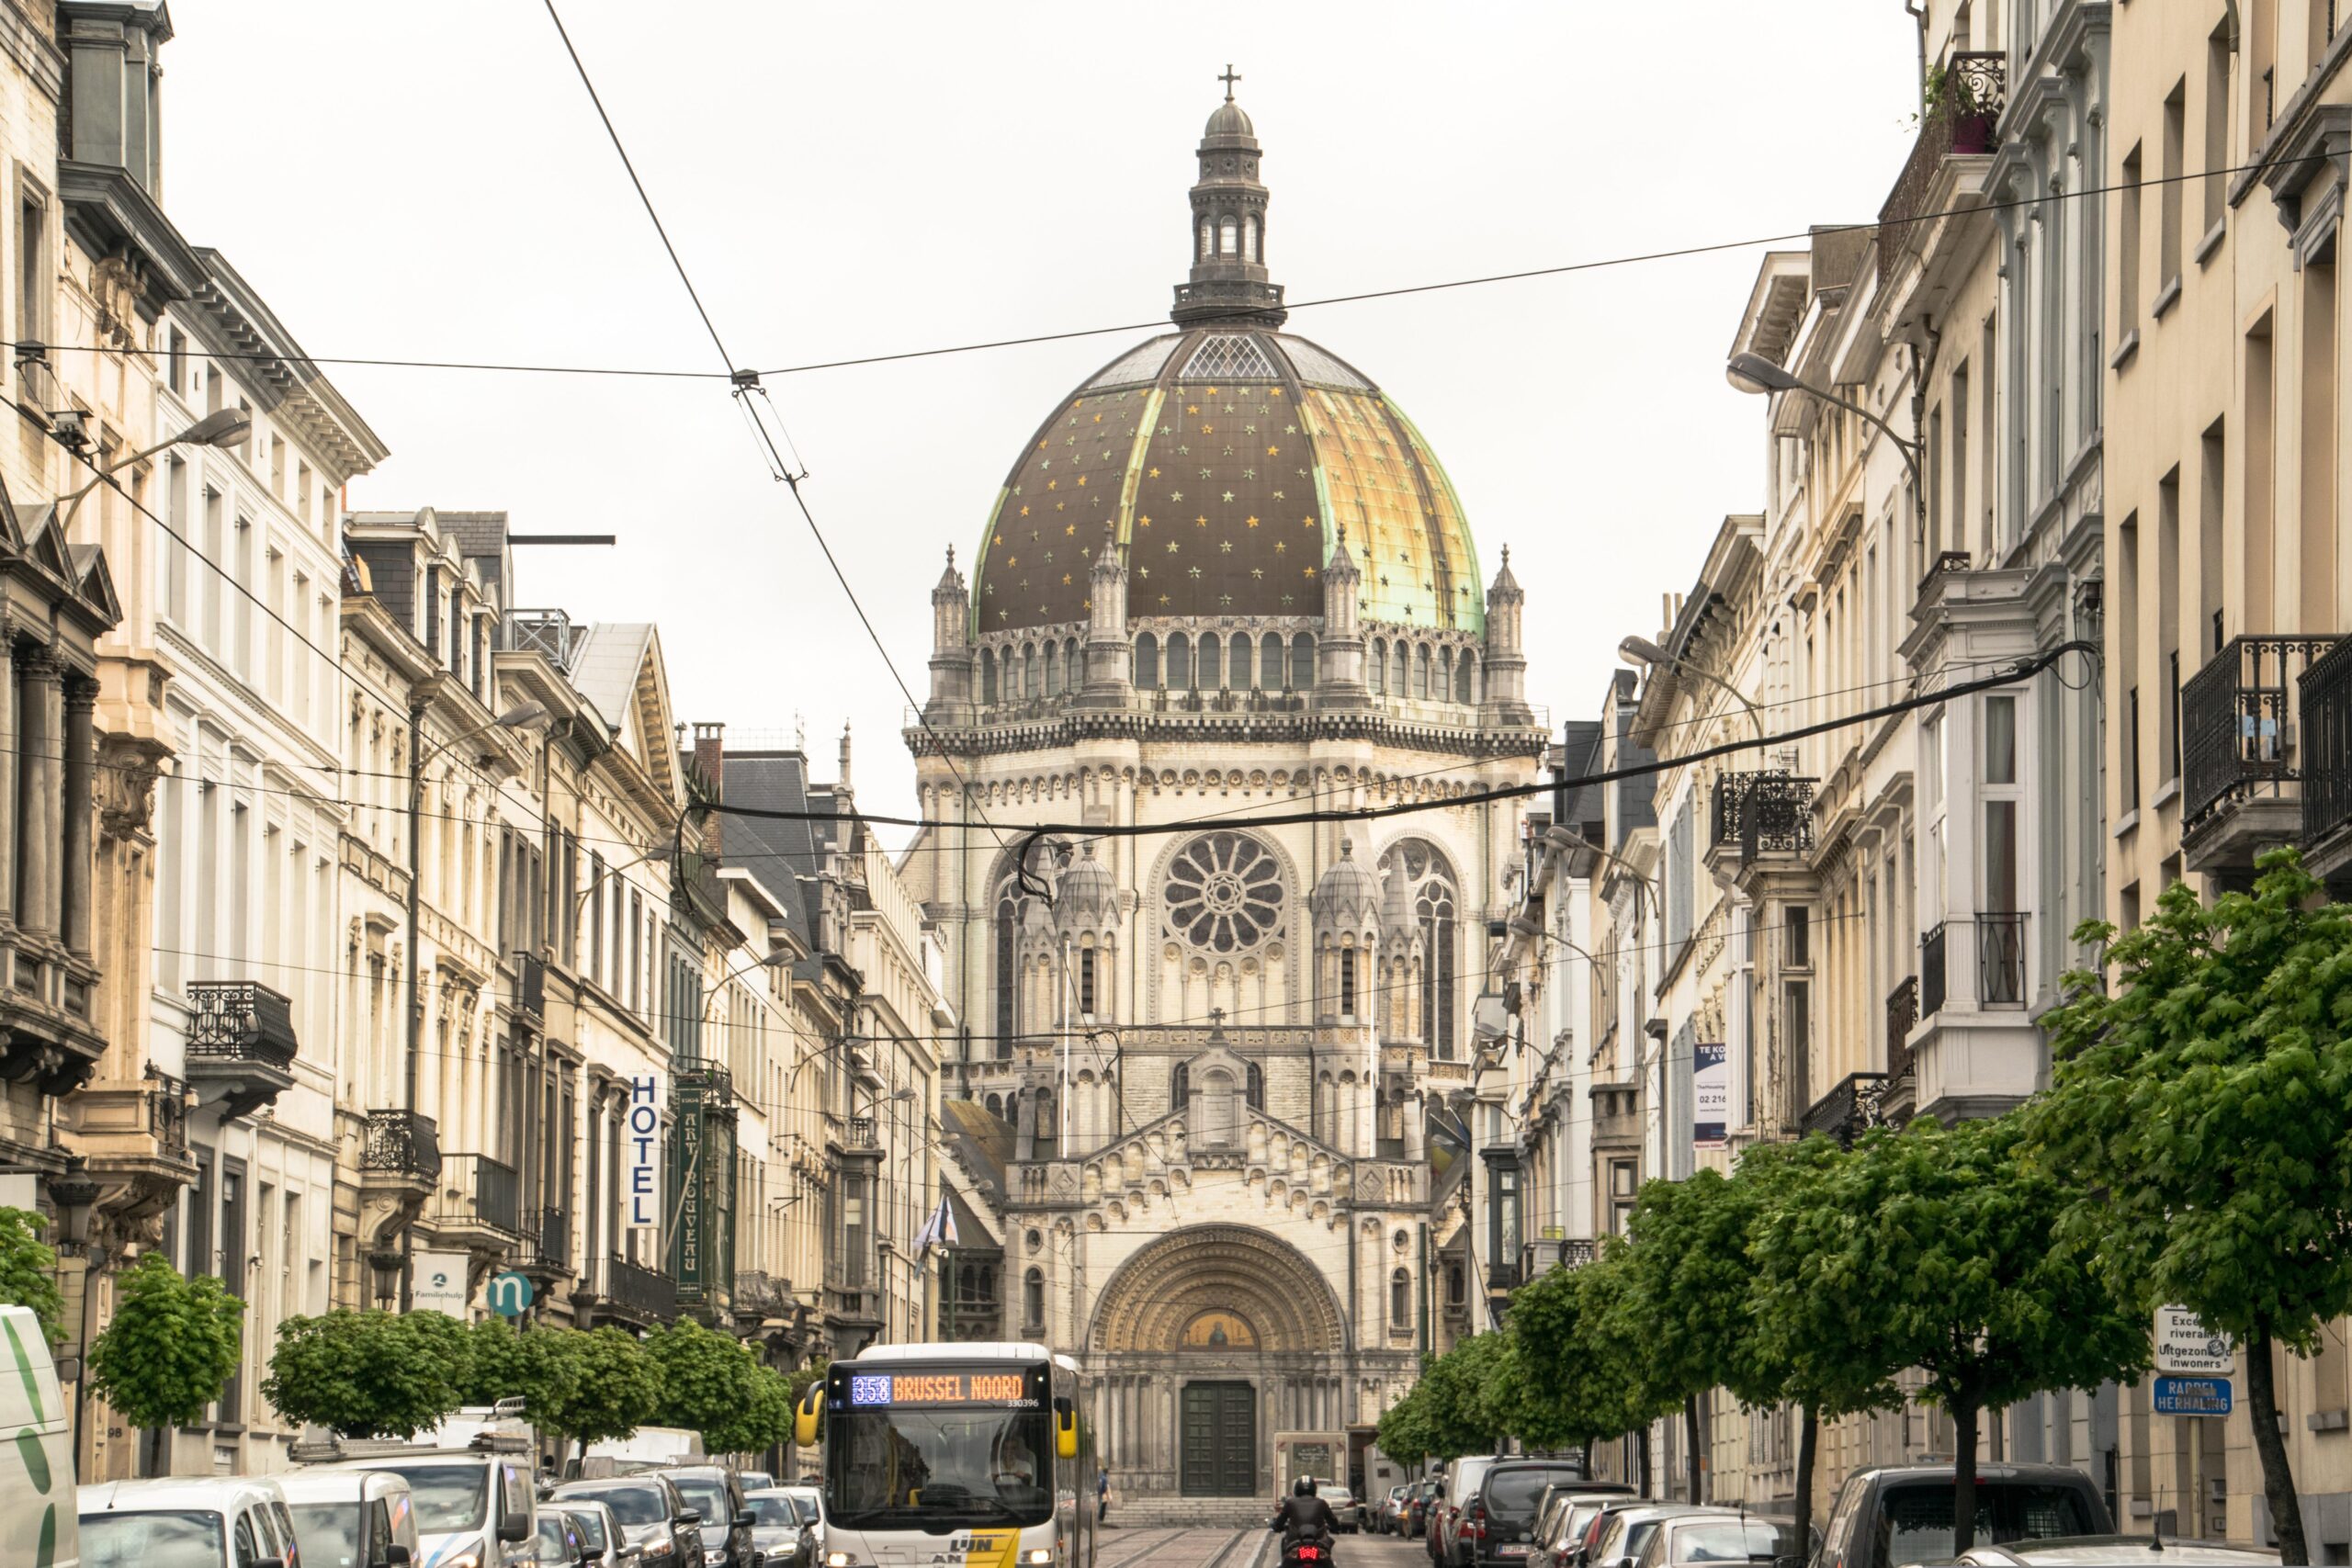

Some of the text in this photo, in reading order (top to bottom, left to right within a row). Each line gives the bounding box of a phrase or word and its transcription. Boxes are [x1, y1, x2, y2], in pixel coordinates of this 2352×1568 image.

[684, 1112, 697, 1156] ART
[631, 1077, 656, 1224] HOTEL
[684, 1170, 697, 1271] NOUVEAU
[415, 1291, 463, 1299] Familiehulp
[2170, 1359, 2221, 1369] inwoners
[854, 1375, 1023, 1403] 358 BRUSSEL NOORD
[1007, 1399, 1039, 1407] 330396
[2158, 1396, 2228, 1411] HERHALING
